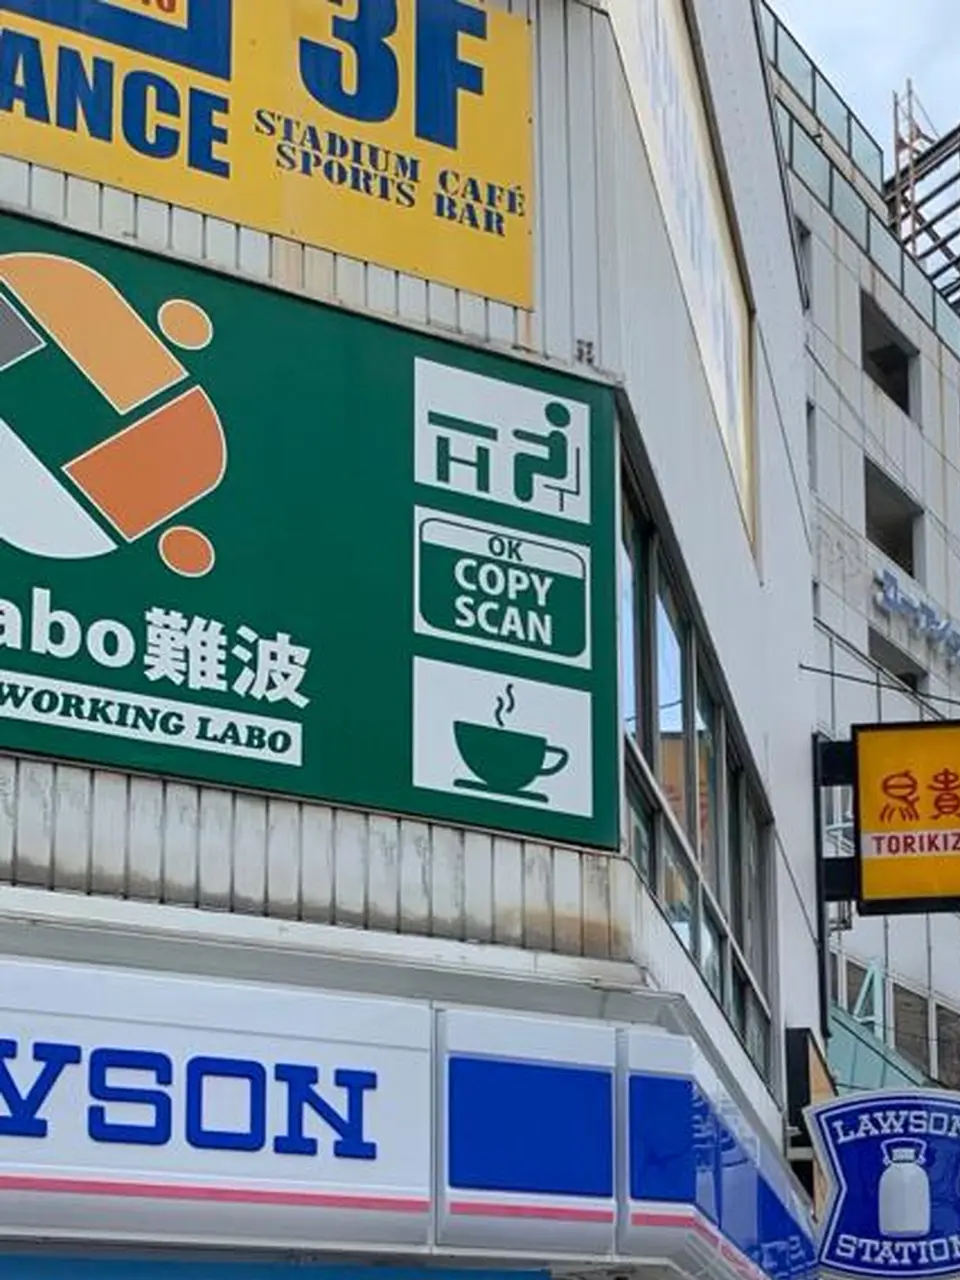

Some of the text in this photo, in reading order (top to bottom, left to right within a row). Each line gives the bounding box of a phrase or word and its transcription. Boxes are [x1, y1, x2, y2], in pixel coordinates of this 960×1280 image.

[254, 108, 526, 217] STADIUM CAFÉ
[276, 142, 506, 238] SPORTS BAR
[487, 531, 523, 563] OK
[453, 557, 554, 609] COPY
[454, 596, 553, 647] SCAN
[195, 715, 293, 754] LABO
